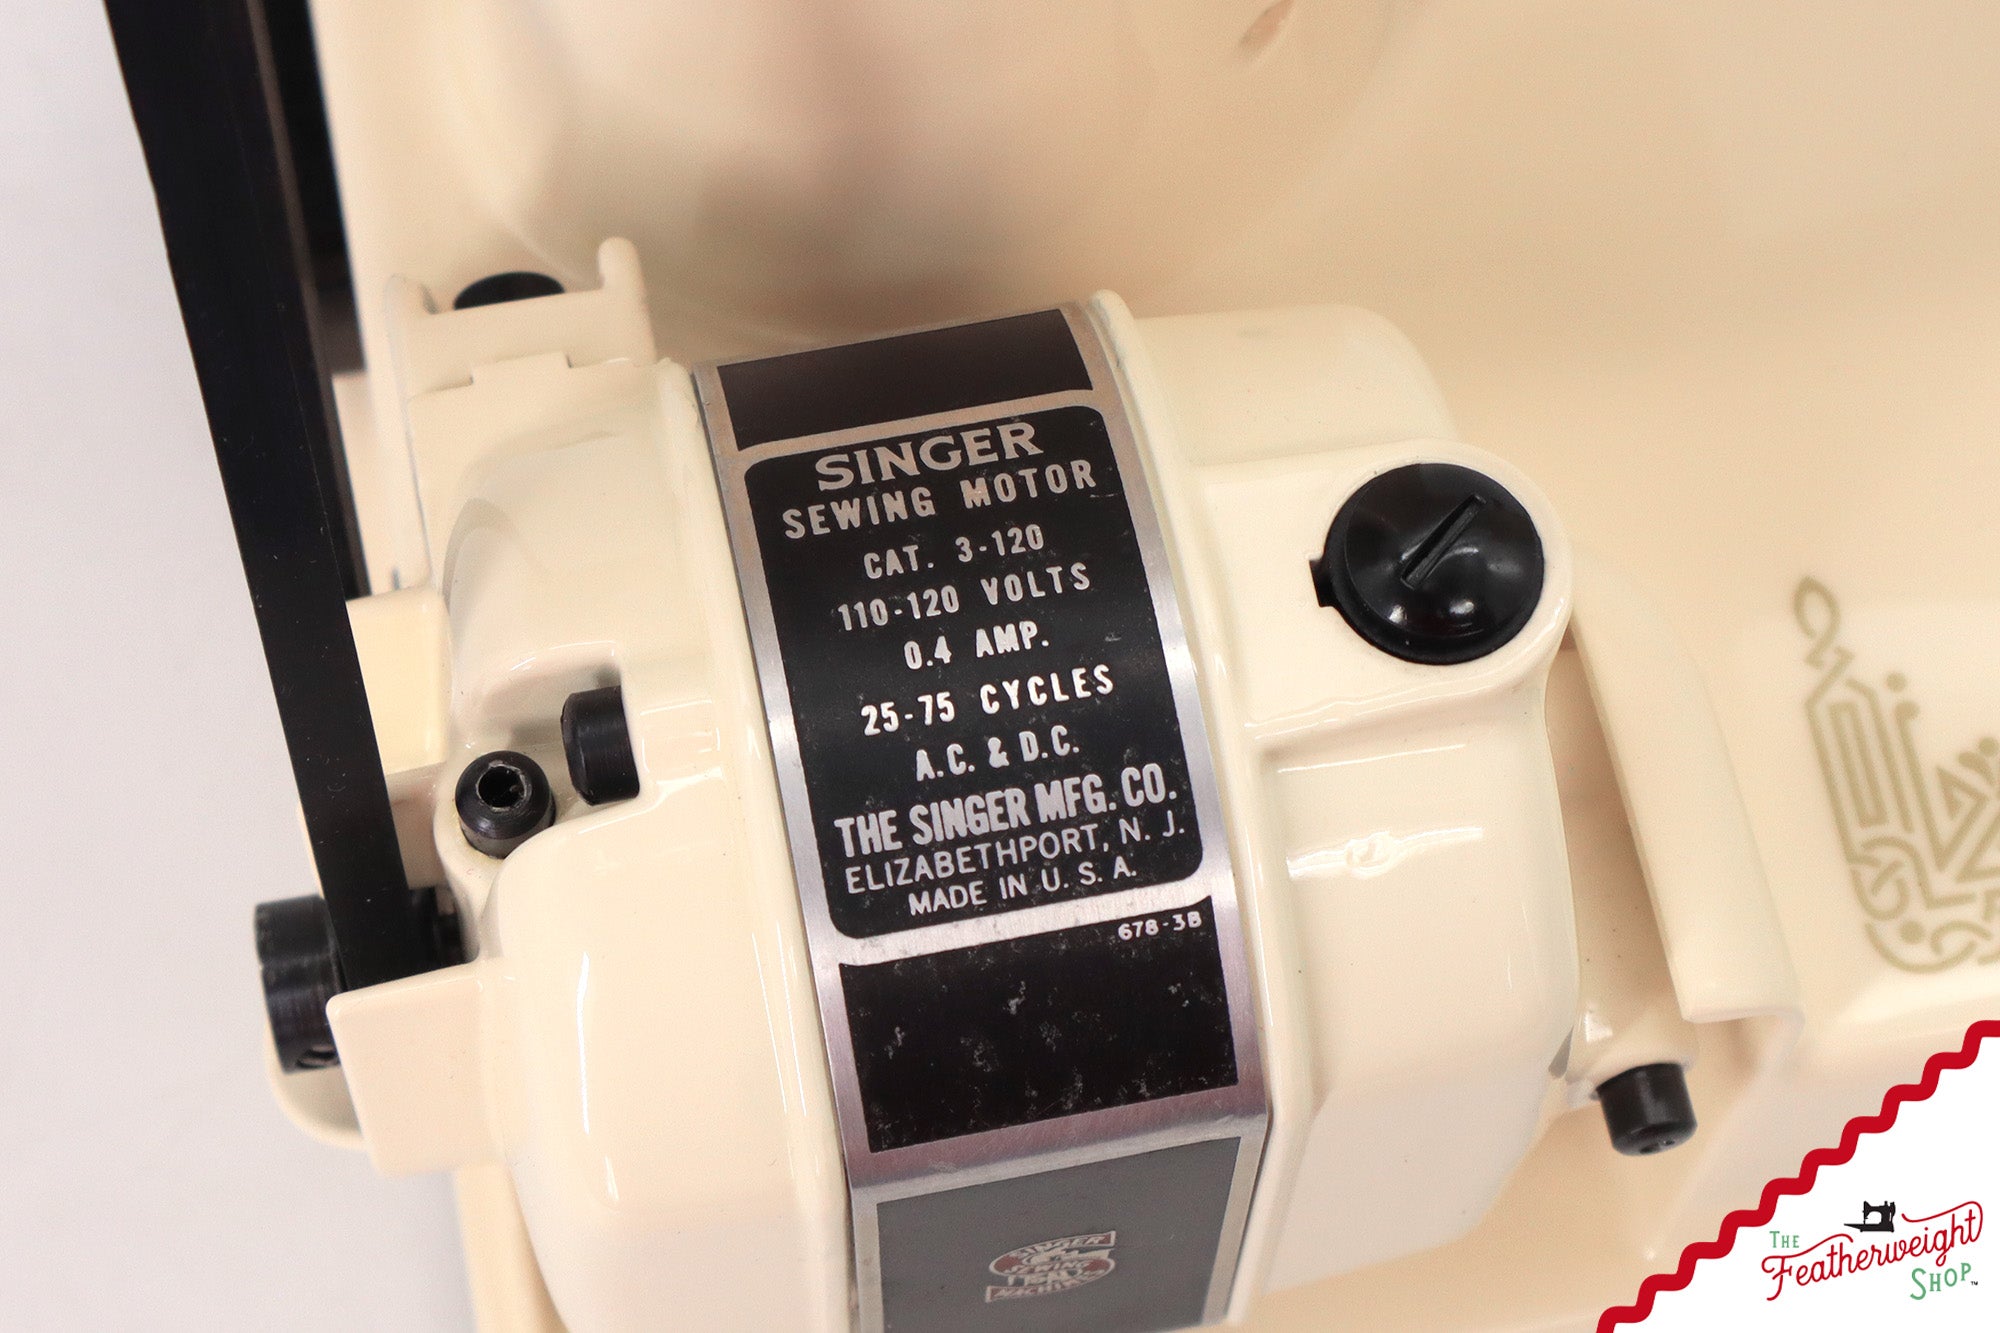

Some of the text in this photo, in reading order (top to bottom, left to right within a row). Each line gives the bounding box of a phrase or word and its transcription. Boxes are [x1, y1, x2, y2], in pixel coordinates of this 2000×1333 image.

[815, 422, 1044, 491] SINGER
[782, 459, 1096, 539] SEWING MOTOR
[864, 524, 1044, 579] CAT. 3-120
[837, 563, 1090, 630] 110-120 VOLTS
[904, 621, 1049, 670] 0.4 AMP.
[861, 665, 1113, 736] 25-75 CYCLES
[916, 725, 1079, 781] A.C. & D.C.
[834, 763, 1177, 858] THE SINGER MFG. CO.
[845, 823, 1109, 894] ELIZABETHPORT,
[908, 884, 987, 916] MADE
[1000, 875, 1028, 900] IN
[1118, 911, 1202, 941] 678-3B
